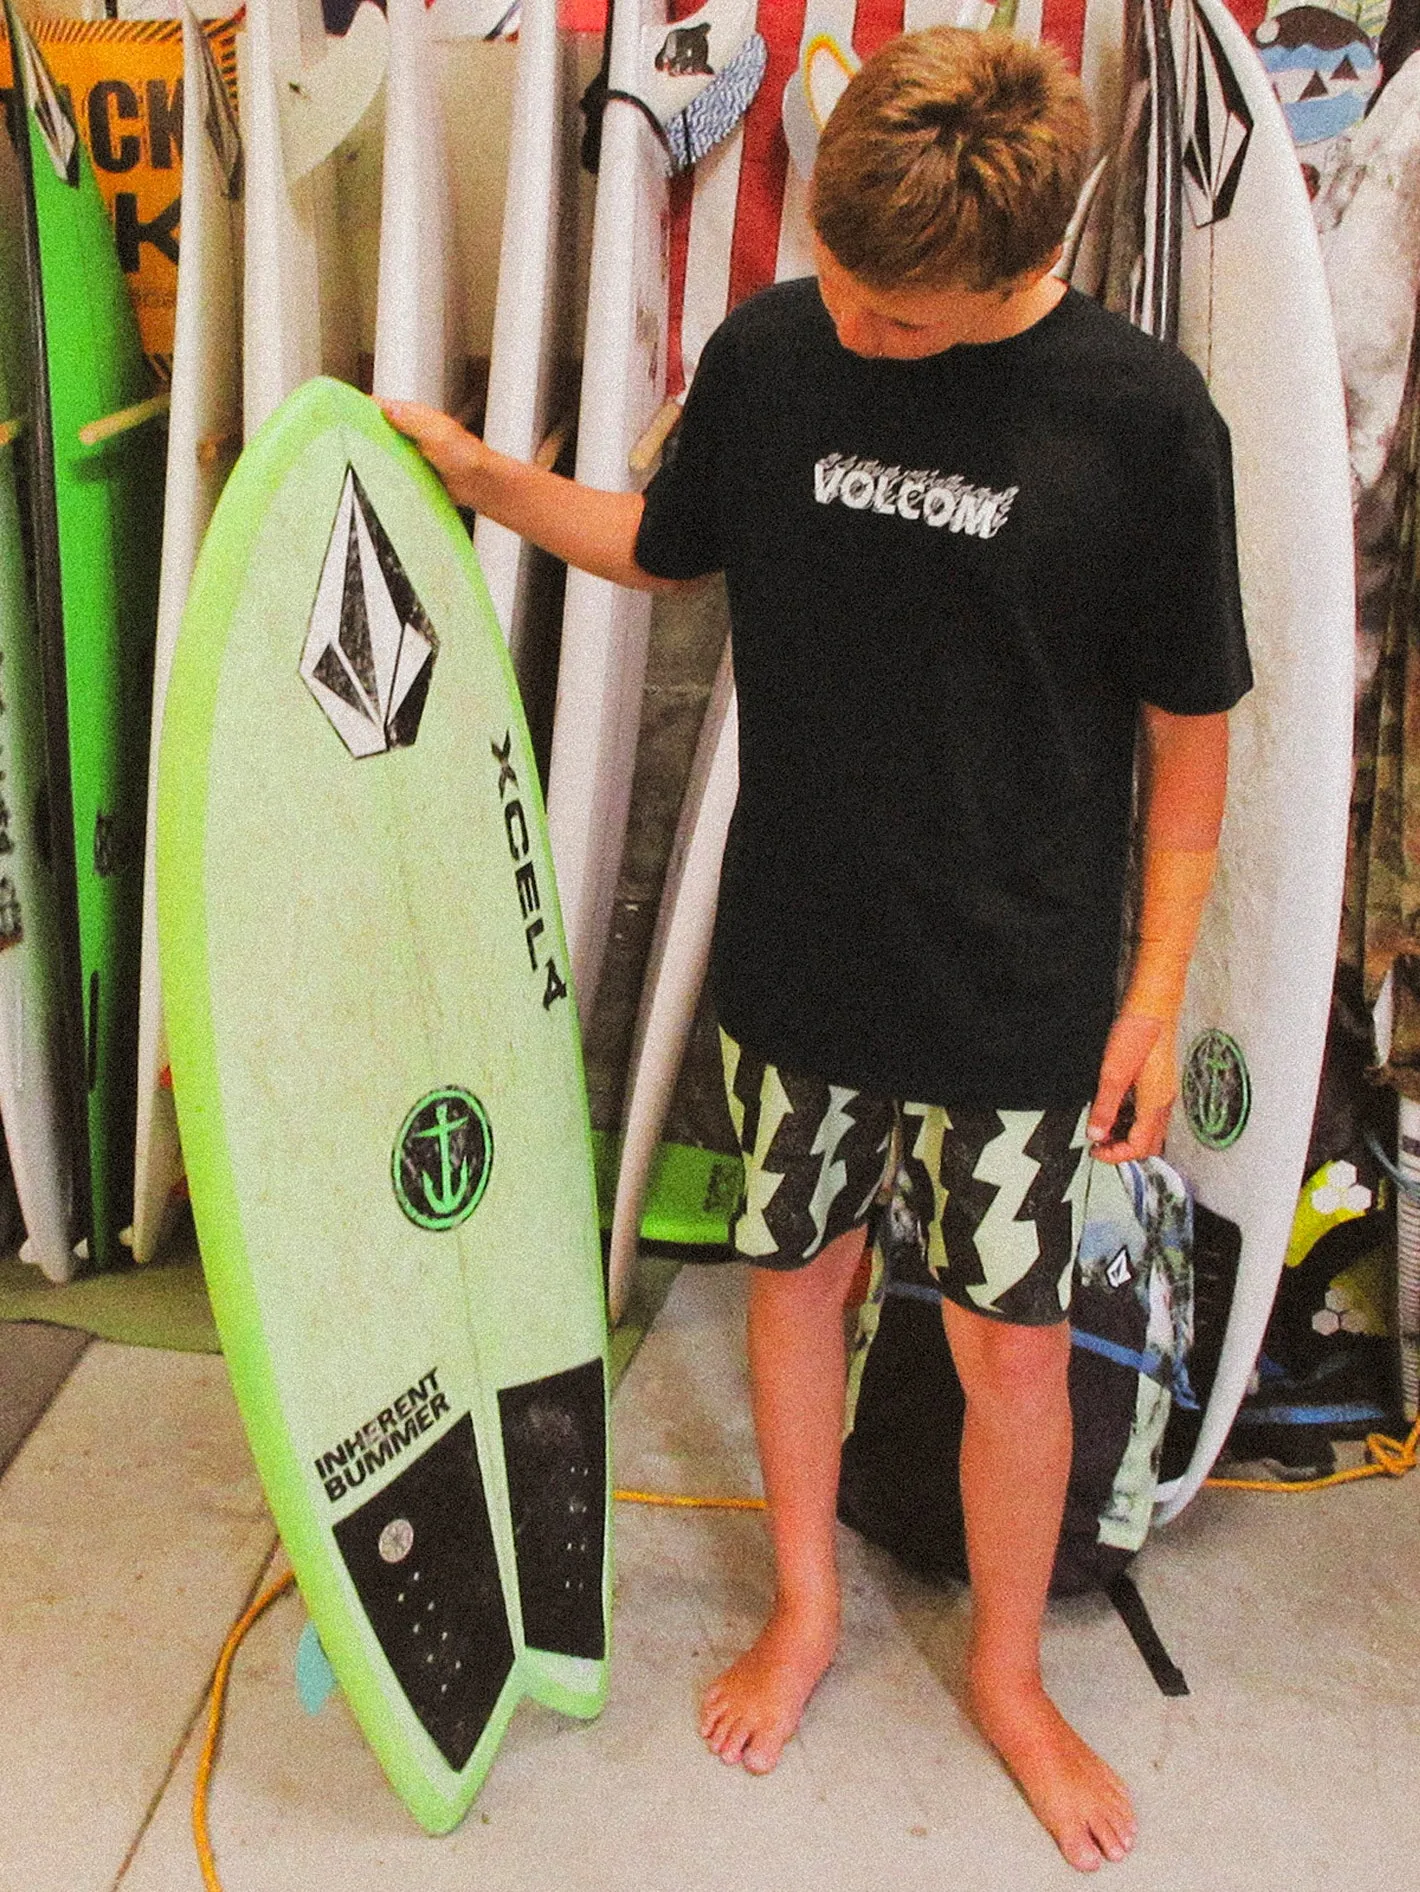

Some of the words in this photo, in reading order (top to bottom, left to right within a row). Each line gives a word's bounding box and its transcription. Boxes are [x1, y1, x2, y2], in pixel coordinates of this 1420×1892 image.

[814, 452, 1019, 539] VOLCOM
[314, 1366, 439, 1480] INHERENT
[323, 1393, 452, 1503] BUMMER
